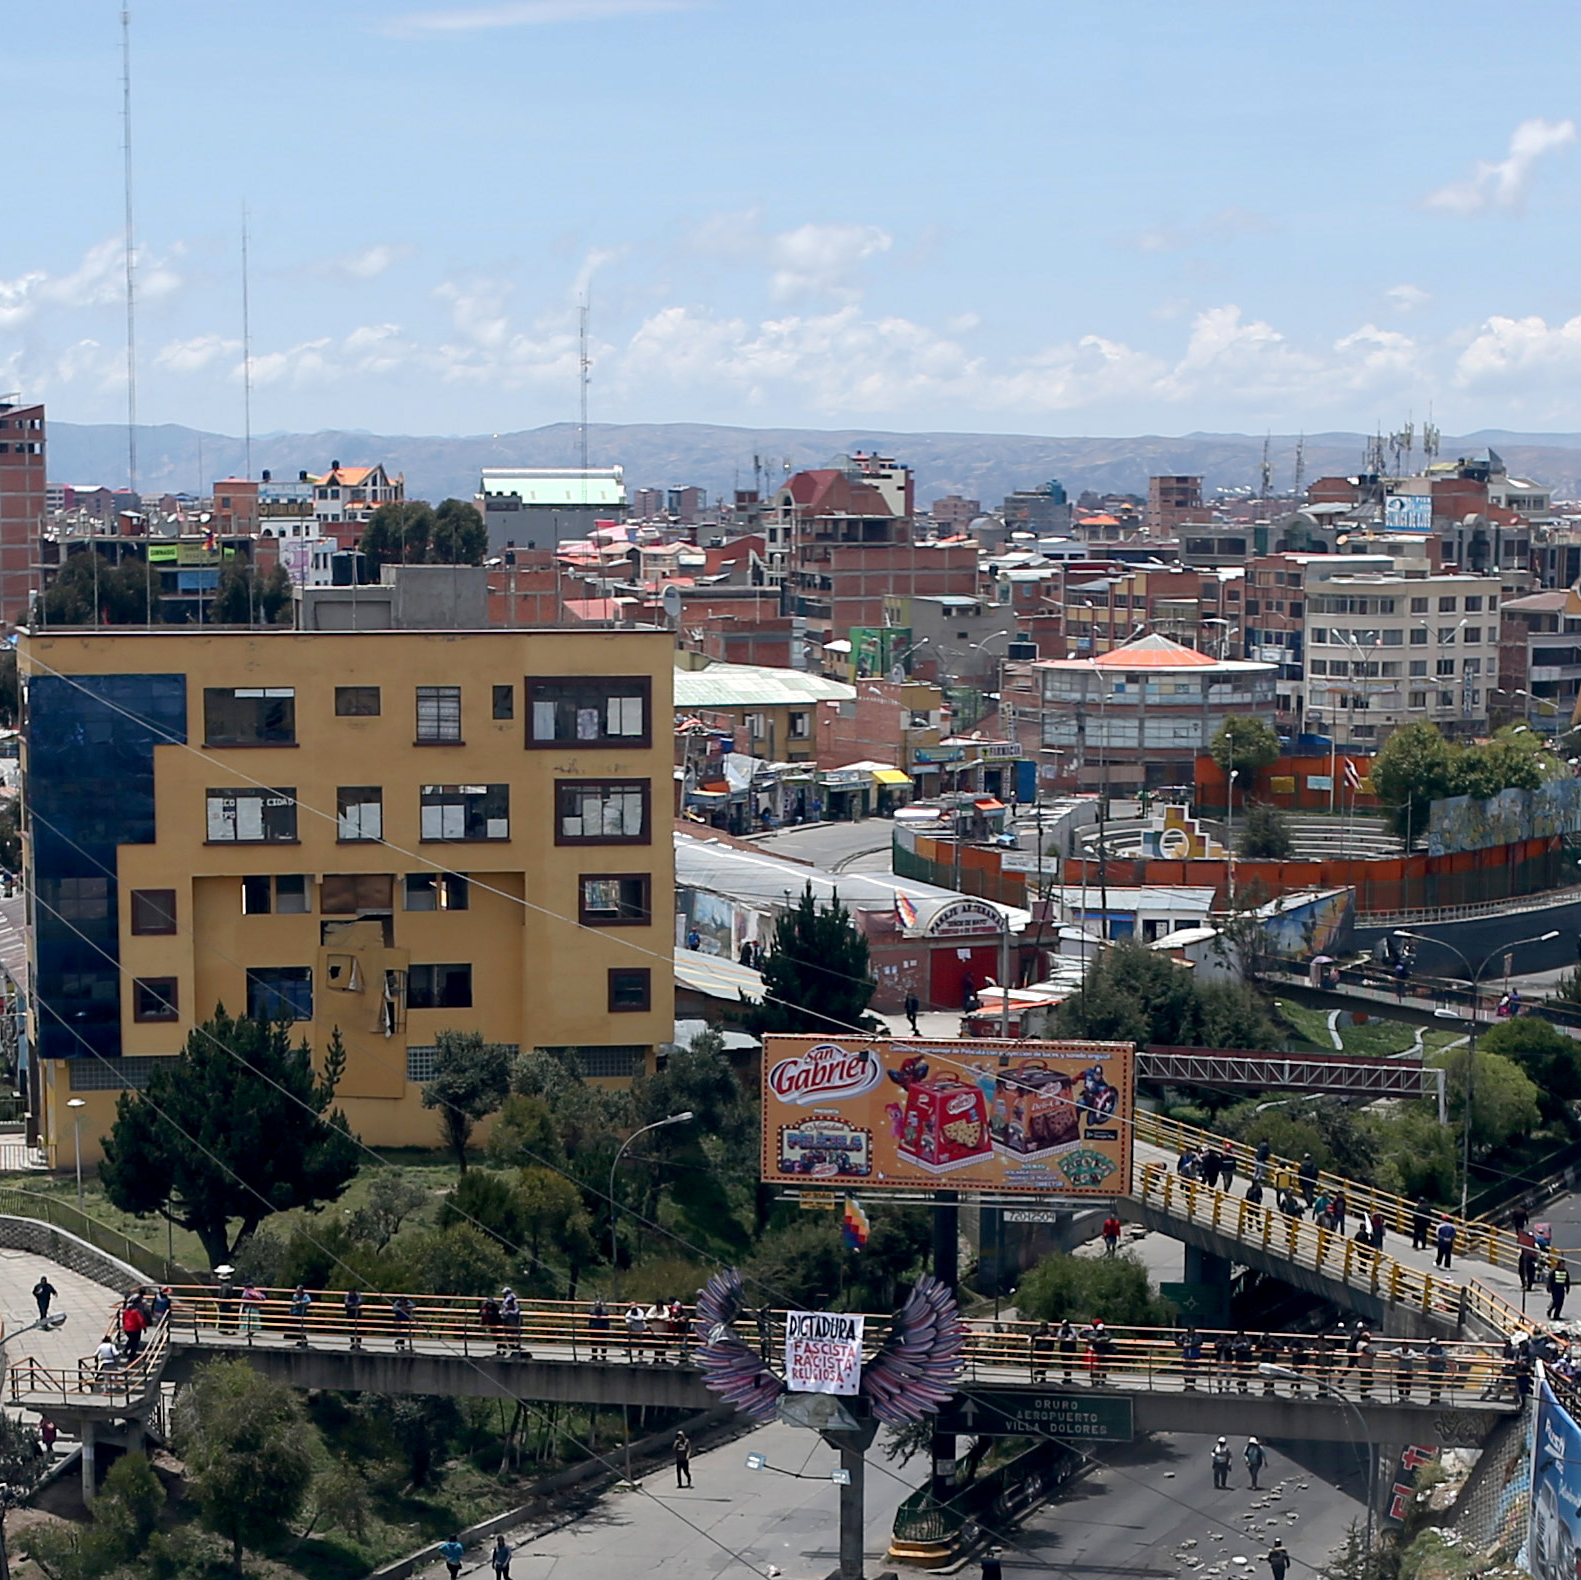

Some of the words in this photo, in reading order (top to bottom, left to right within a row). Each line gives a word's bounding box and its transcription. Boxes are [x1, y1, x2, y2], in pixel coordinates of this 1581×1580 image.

[805, 1048, 834, 1064] San
[777, 1053, 868, 1095] Gabriel
[789, 1315, 856, 1340] DICTADURA
[794, 1340, 855, 1357] FASCISTA
[794, 1354, 852, 1372] RACISTA
[792, 1367, 844, 1383] RELIGIOSA
[1035, 1400, 1078, 1410] ORURO
[1016, 1410, 1098, 1422] AEROPUERTO
[1005, 1421, 1040, 1431] VILLA
[1050, 1424, 1107, 1434] DOLORES
